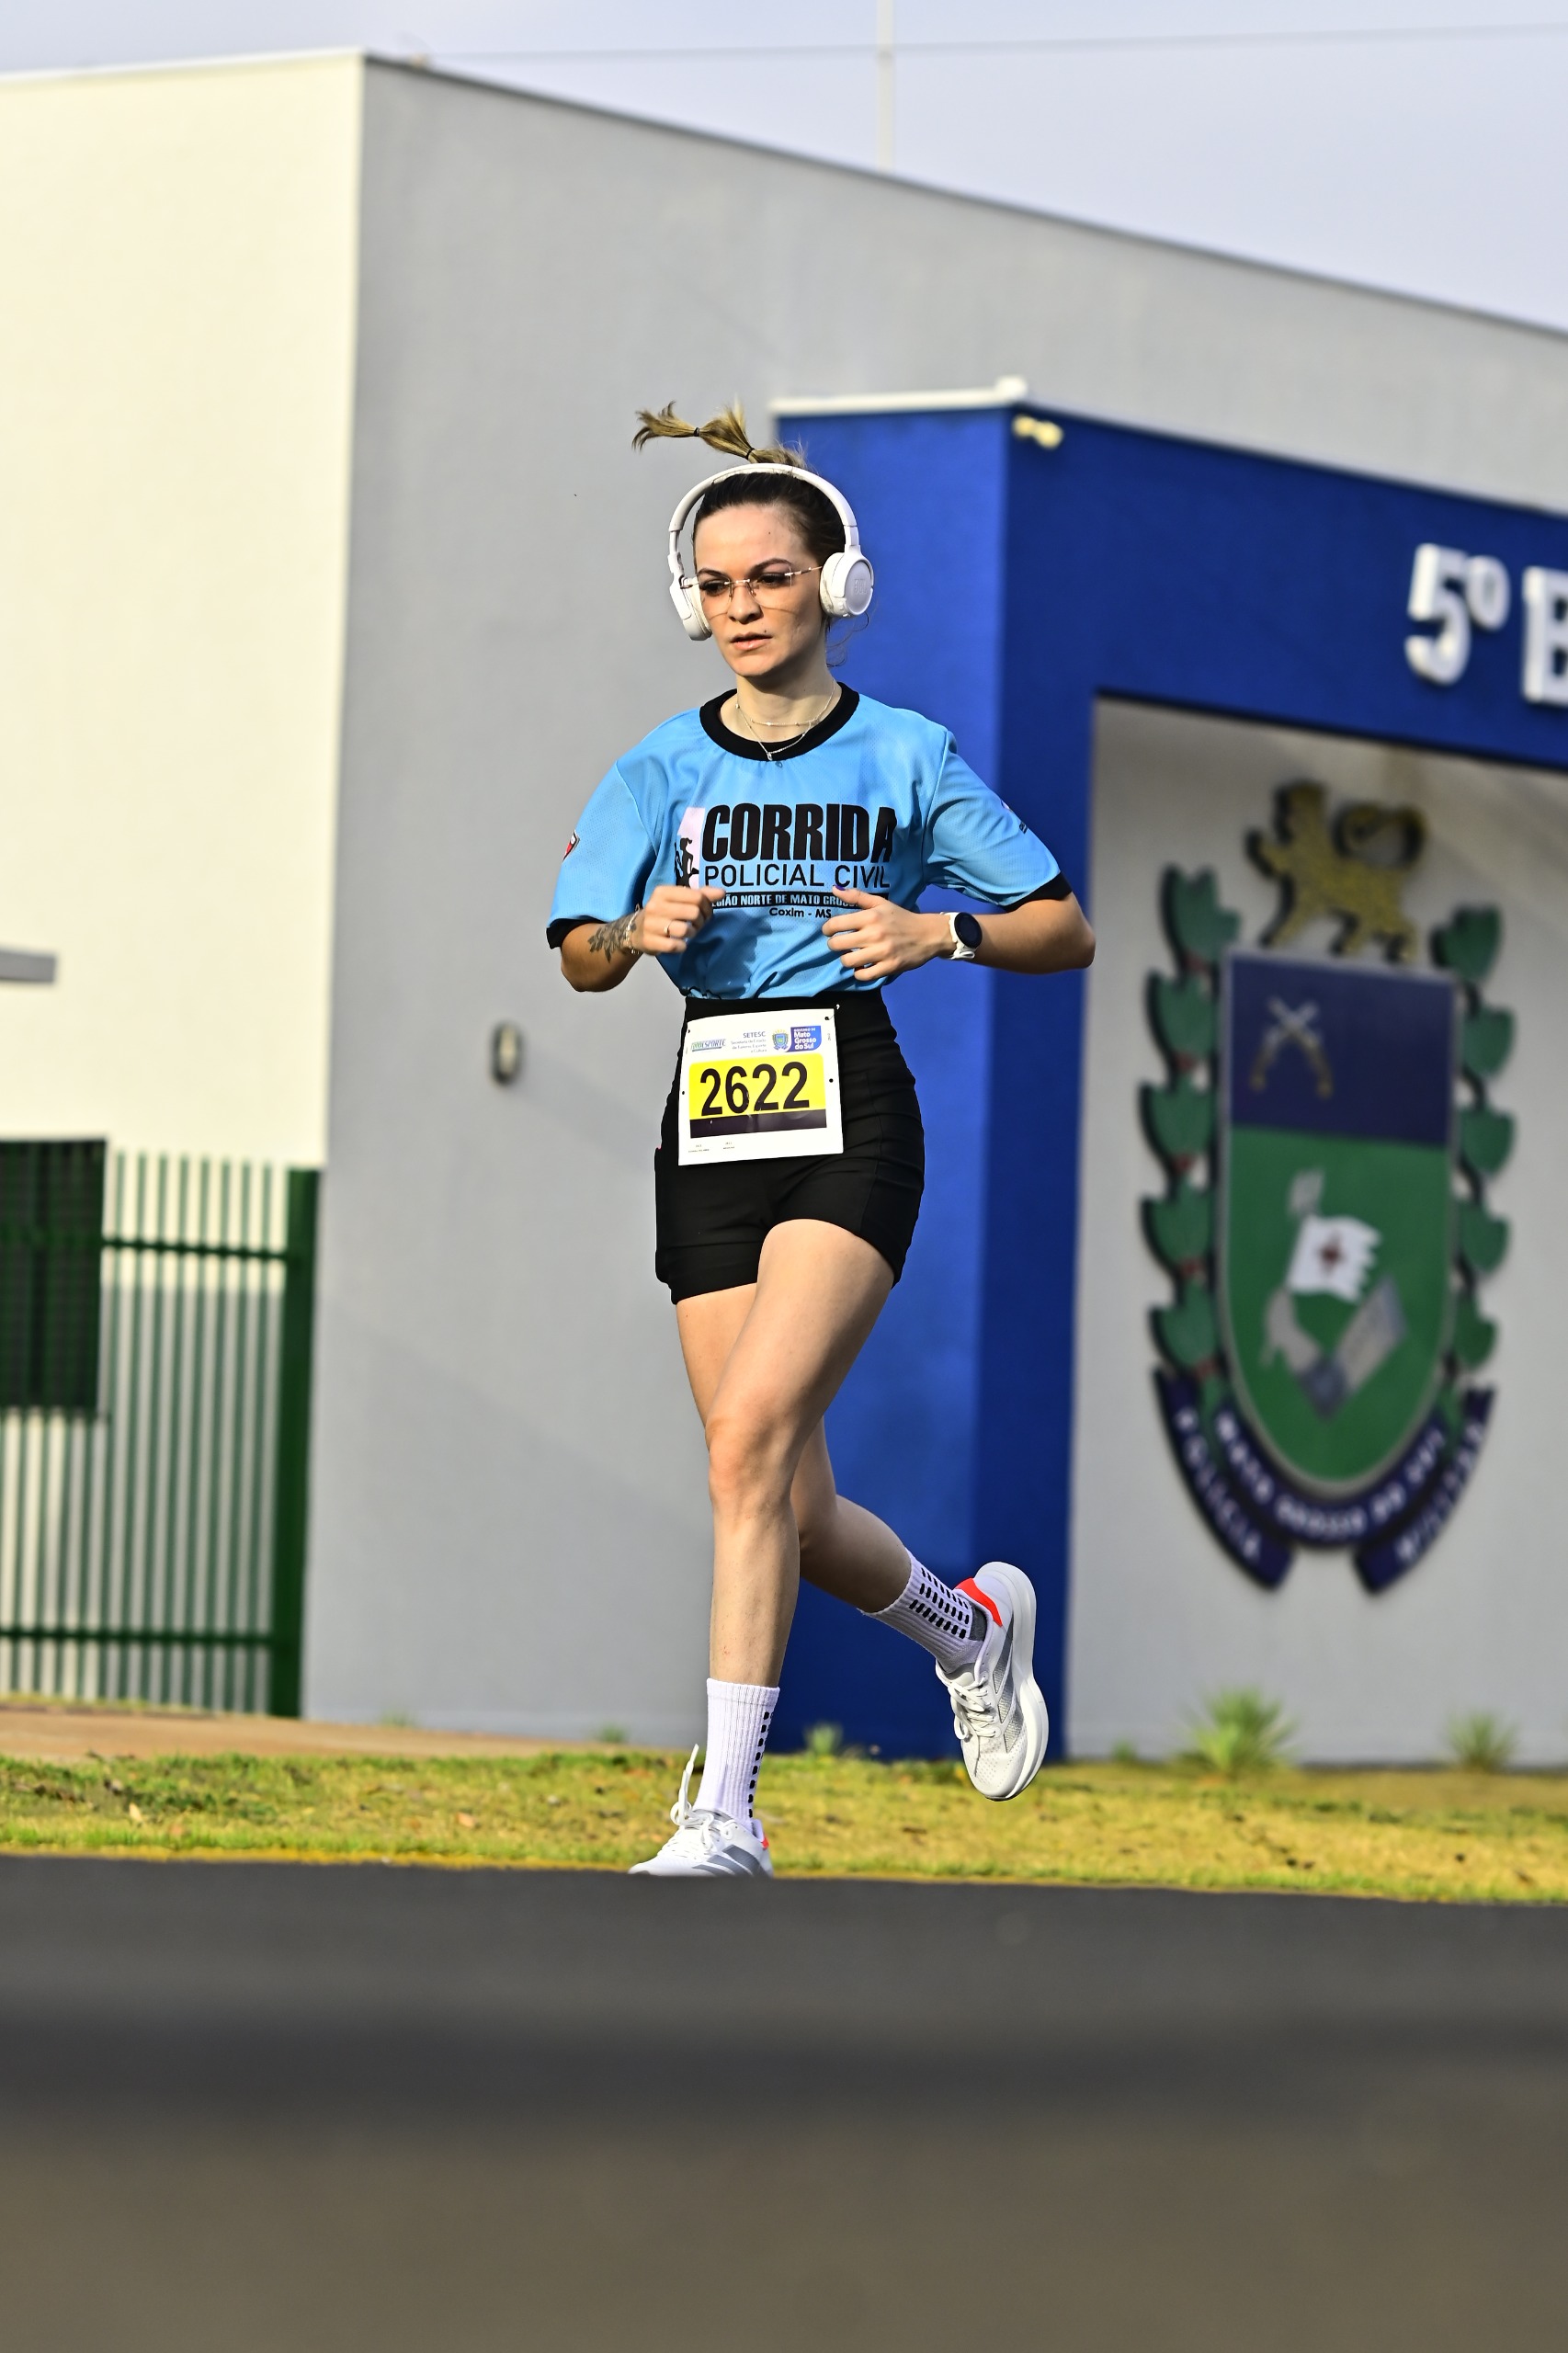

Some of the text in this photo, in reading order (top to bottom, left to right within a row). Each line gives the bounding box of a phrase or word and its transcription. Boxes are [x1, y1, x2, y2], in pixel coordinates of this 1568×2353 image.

[701, 802, 898, 863] CORRIDA
[704, 863, 891, 889] POLICIAL CIVIL
[740, 894, 772, 906] NORTE
[775, 894, 788, 904] DE
[790, 894, 821, 905] MATO
[769, 907, 804, 917] Coxim
[815, 908, 832, 918] MS
[795, 1042, 803, 1051] do
[699, 1061, 811, 1117] 2622
